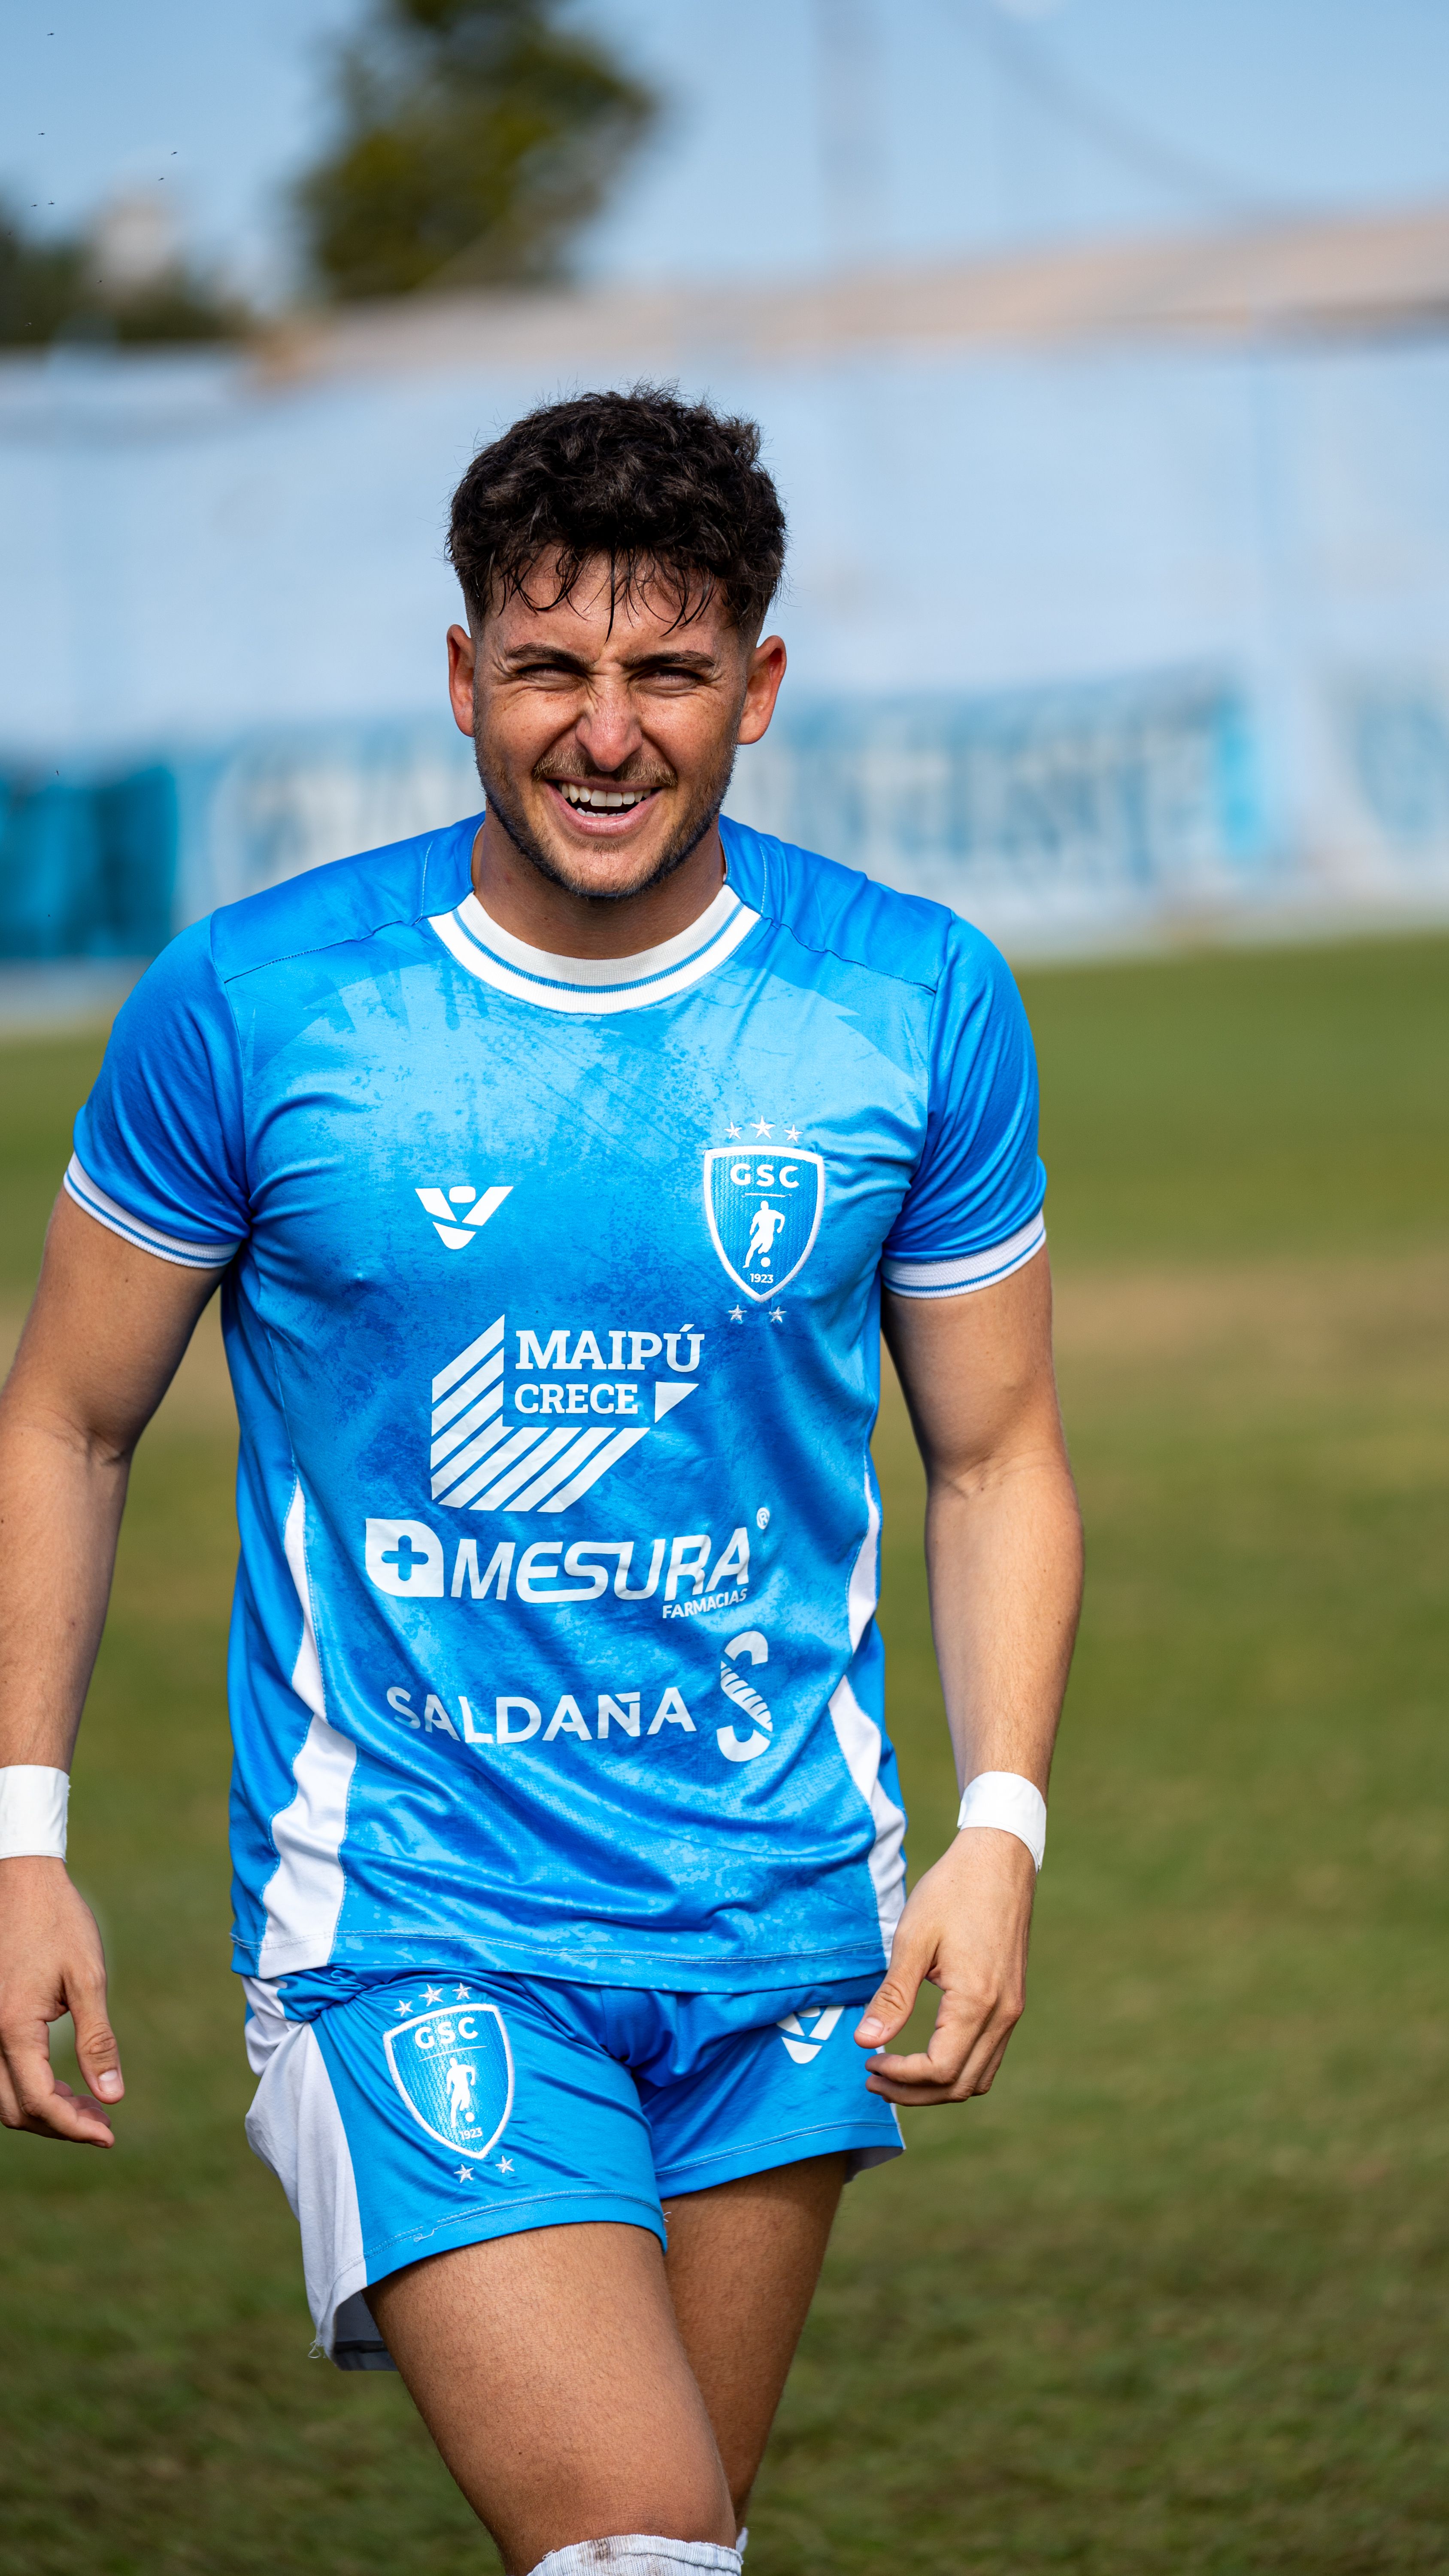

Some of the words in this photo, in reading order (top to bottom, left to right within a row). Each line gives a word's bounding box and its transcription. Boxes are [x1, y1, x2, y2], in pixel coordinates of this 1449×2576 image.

[730, 1163, 799, 1188] GSC
[750, 1273, 773, 1284] 1923
[515, 1324, 704, 1372] MAIPÚ
[515, 1383, 638, 1414] CRECE
[451, 1527, 750, 1604] MESURA
[662, 1588, 747, 1619] FARMACIAS
[386, 1686, 697, 1744] SALDAÑA
[415, 2017, 478, 2049] GSC
[459, 2127, 482, 2140] 1923
